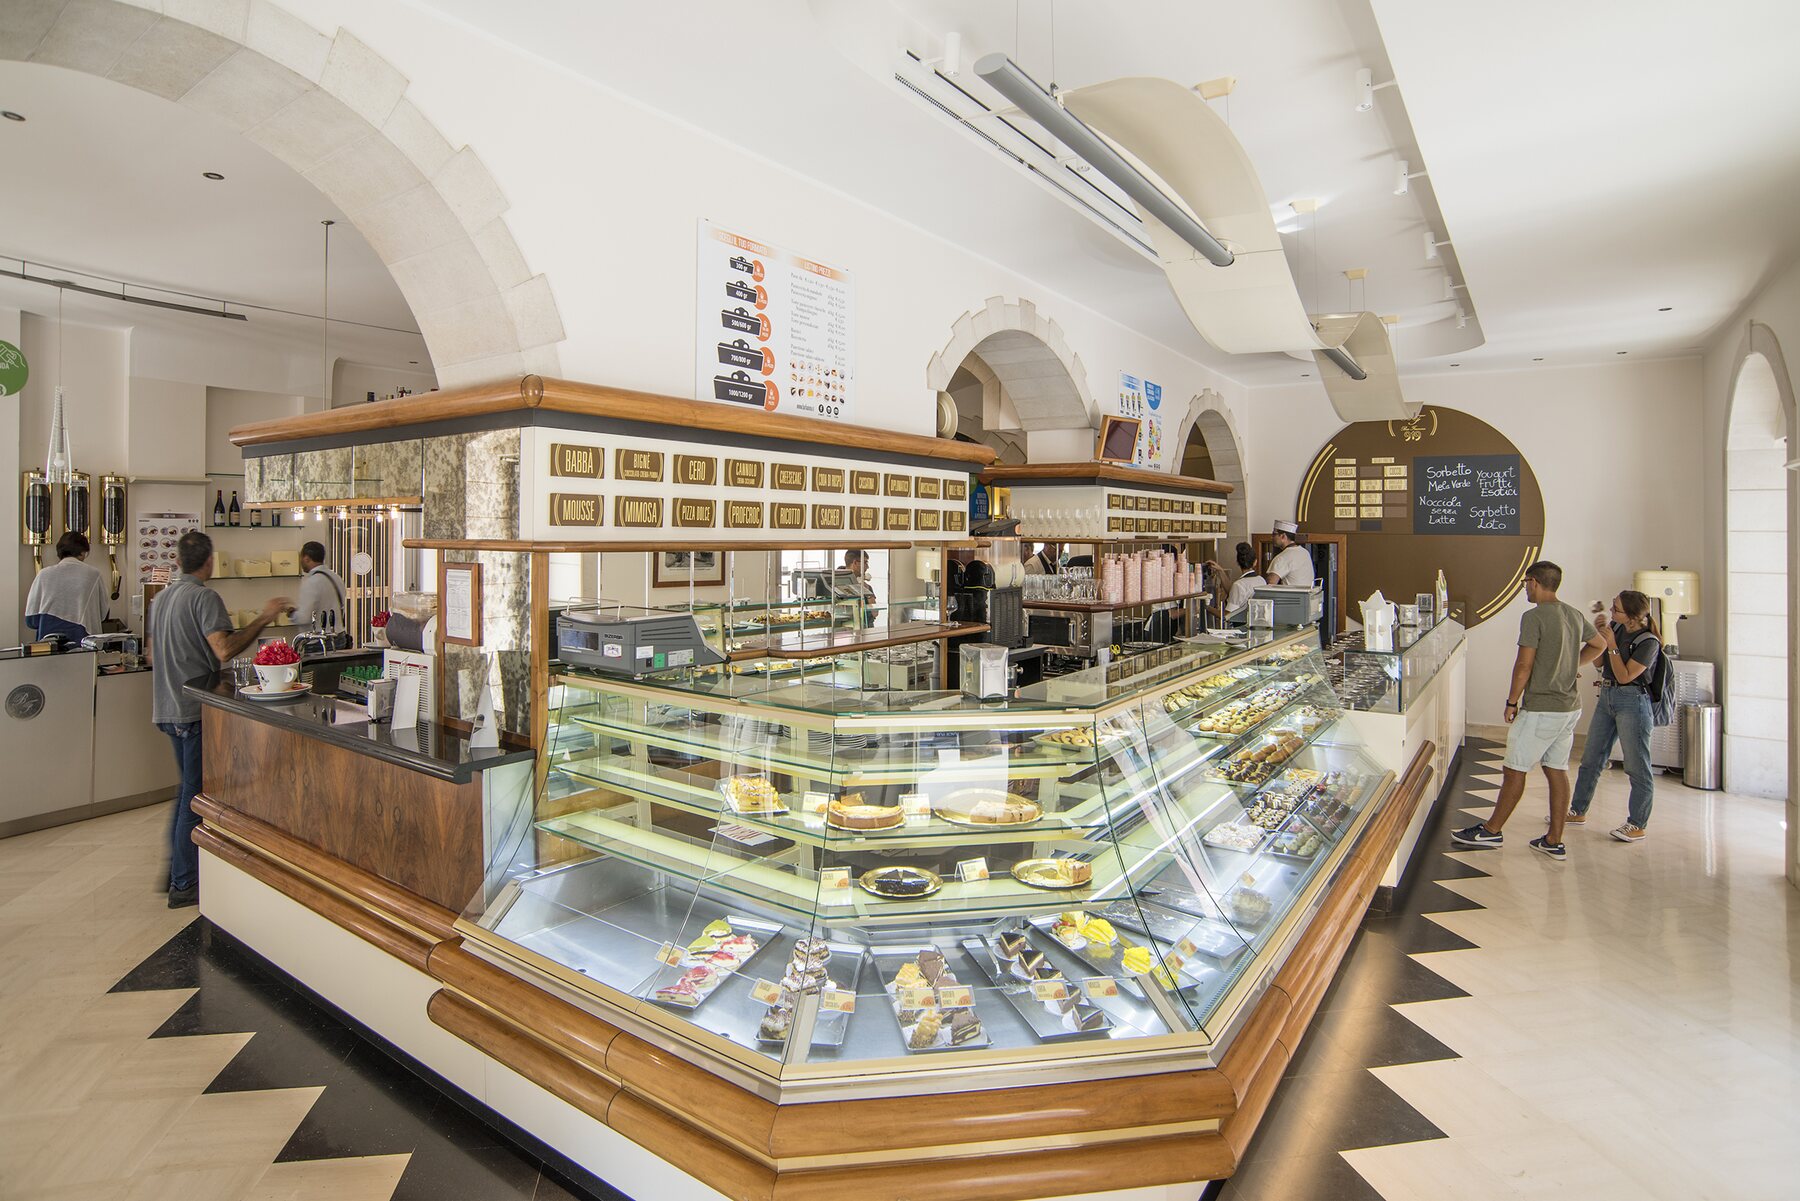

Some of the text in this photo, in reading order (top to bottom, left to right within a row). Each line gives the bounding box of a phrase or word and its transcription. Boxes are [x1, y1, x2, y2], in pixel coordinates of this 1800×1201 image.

[565, 448, 593, 473] BABBÀ
[688, 460, 706, 481] CERO
[735, 462, 757, 478] CANNOLO
[779, 470, 802, 485] CHEESECAKE
[1427, 463, 1472, 478] Sorbetto
[1428, 479, 1471, 492] Mela Verde
[1480, 478, 1513, 488] Frutti
[1419, 496, 1462, 507] Nocciola
[562, 499, 595, 521] MOUSSE
[625, 501, 657, 524] MIMOSA
[682, 505, 710, 522] PIZZA DOLCE
[820, 508, 840, 526] SACHER
[1470, 504, 1516, 518] Sorbetto
[1428, 515, 1456, 525] Latte
[1477, 518, 1507, 530] Loto
